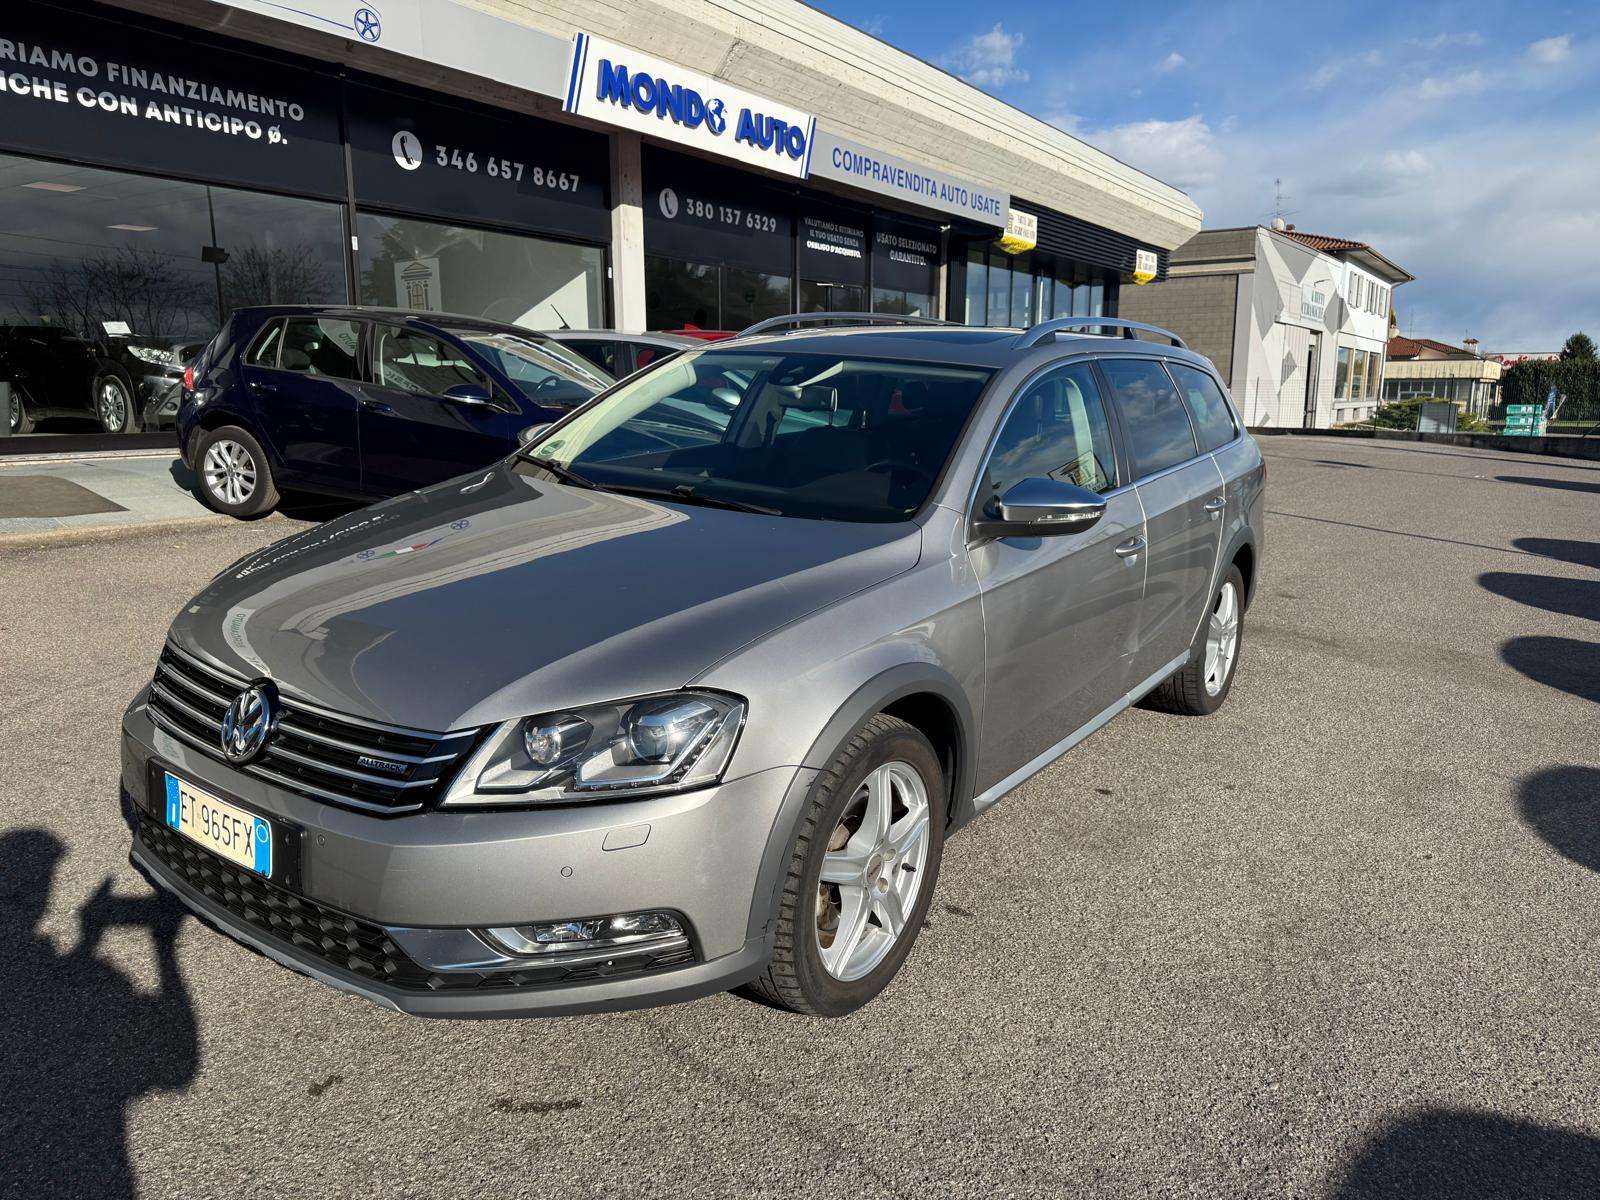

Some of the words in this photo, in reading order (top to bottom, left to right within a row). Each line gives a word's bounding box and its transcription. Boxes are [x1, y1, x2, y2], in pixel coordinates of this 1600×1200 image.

[76, 86, 139, 117] CON
[145, 101, 262, 140] ANTICIPO
[106, 61, 305, 122] FINANZIAMENTO
[735, 108, 806, 161] AUTO
[436, 144, 478, 173] 346
[487, 156, 524, 181] 657
[533, 166, 580, 192] 8667
[832, 147, 938, 199] COMPRAVENDITA
[940, 183, 968, 206] AUTO
[970, 192, 1000, 216] USATE
[686, 198, 714, 220] 380
[719, 206, 741, 225] 137
[746, 213, 777, 233] 6329
[876, 231, 897, 246] USATO
[898, 236, 937, 254] SELEZIONATO
[359, 757, 402, 772] ALLTRACK
[181, 789, 196, 829] ET
[201, 804, 253, 859] 965FX
